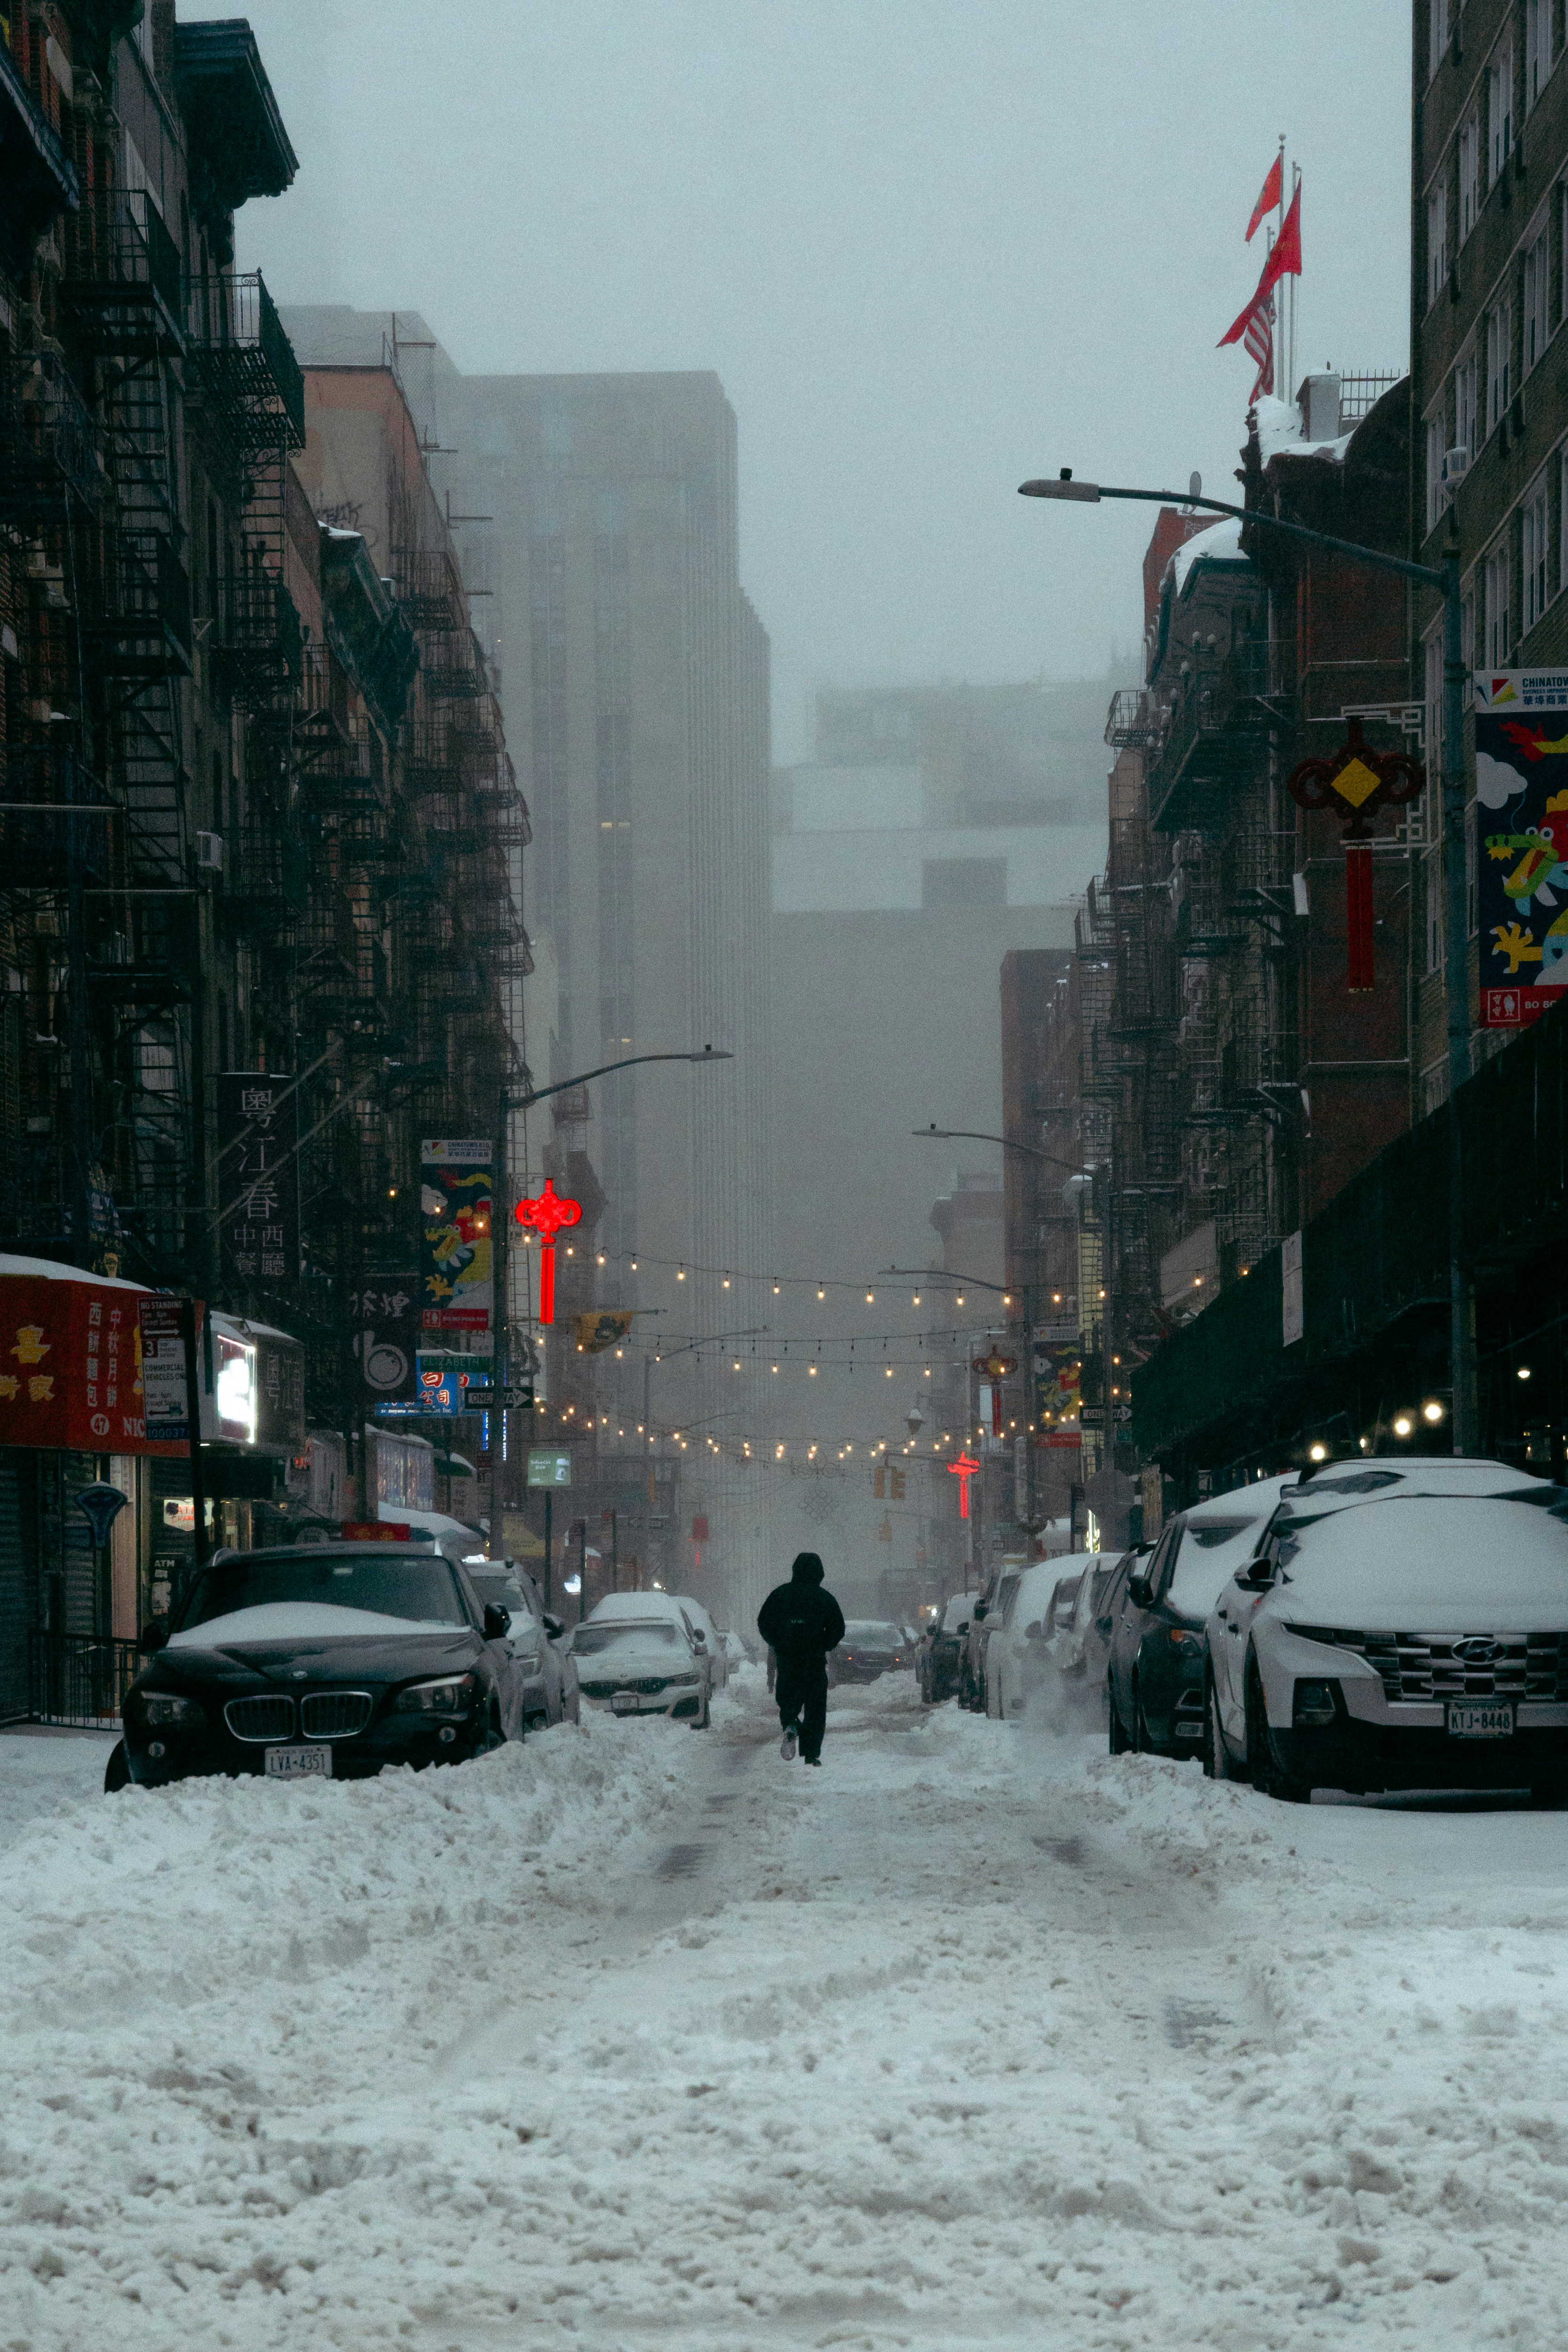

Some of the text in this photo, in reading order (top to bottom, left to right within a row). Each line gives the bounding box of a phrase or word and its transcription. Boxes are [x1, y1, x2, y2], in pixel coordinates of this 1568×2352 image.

[1524, 1001, 1539, 1009] BO
[151, 1300, 183, 1309] STANDING
[146, 1341, 154, 1356] 3
[422, 1357, 479, 1367] ELIZABETH
[420, 1389, 450, 1406] 公司
[471, 1394, 490, 1403] ONE
